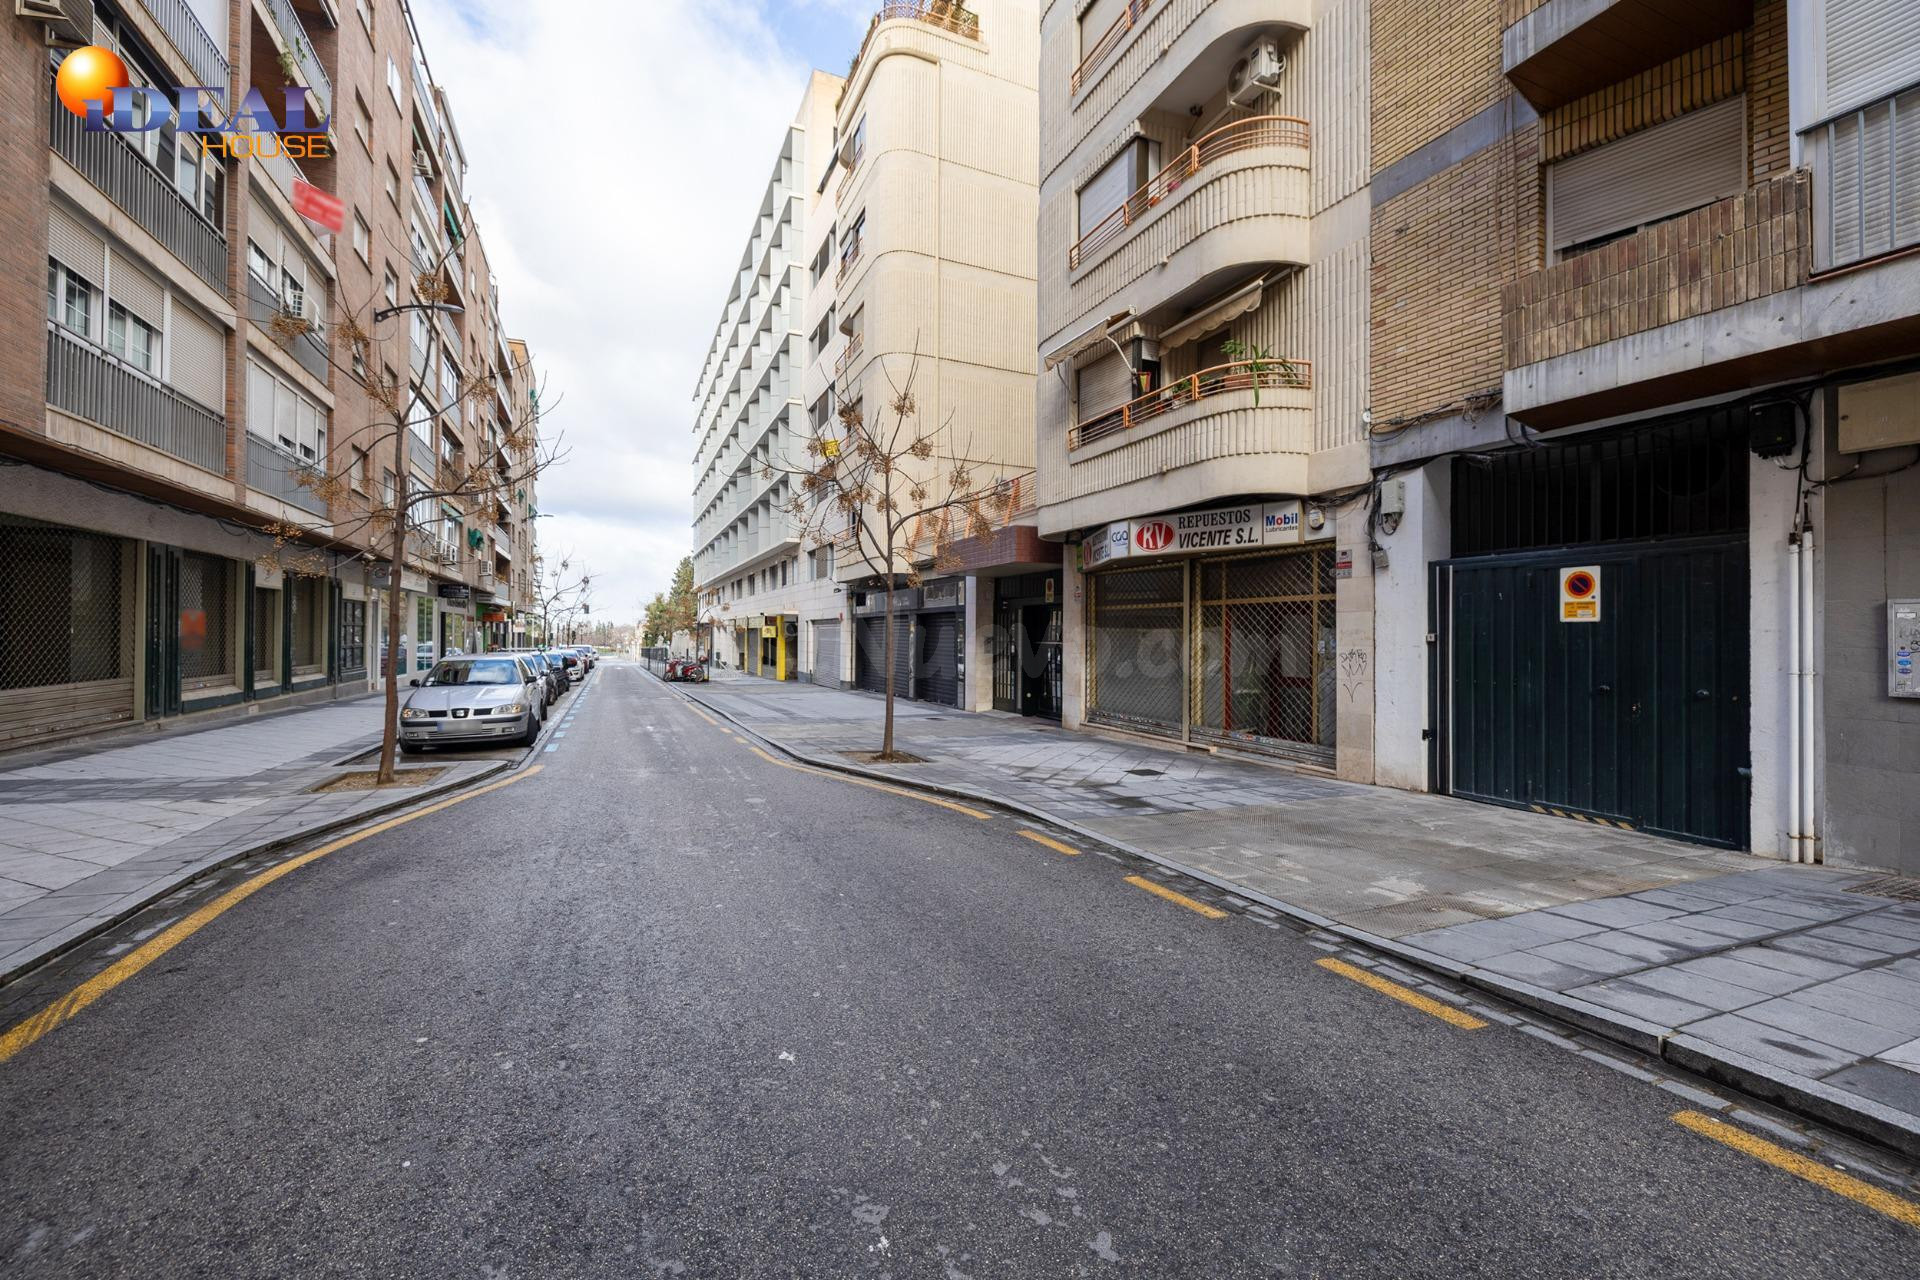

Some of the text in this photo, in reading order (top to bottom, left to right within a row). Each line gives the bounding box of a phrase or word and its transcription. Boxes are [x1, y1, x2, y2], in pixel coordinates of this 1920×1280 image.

[1178, 509, 1251, 530] REPUESTOS
[1265, 513, 1298, 527] Mobil
[1179, 527, 1259, 549] VICENTE S.L.
